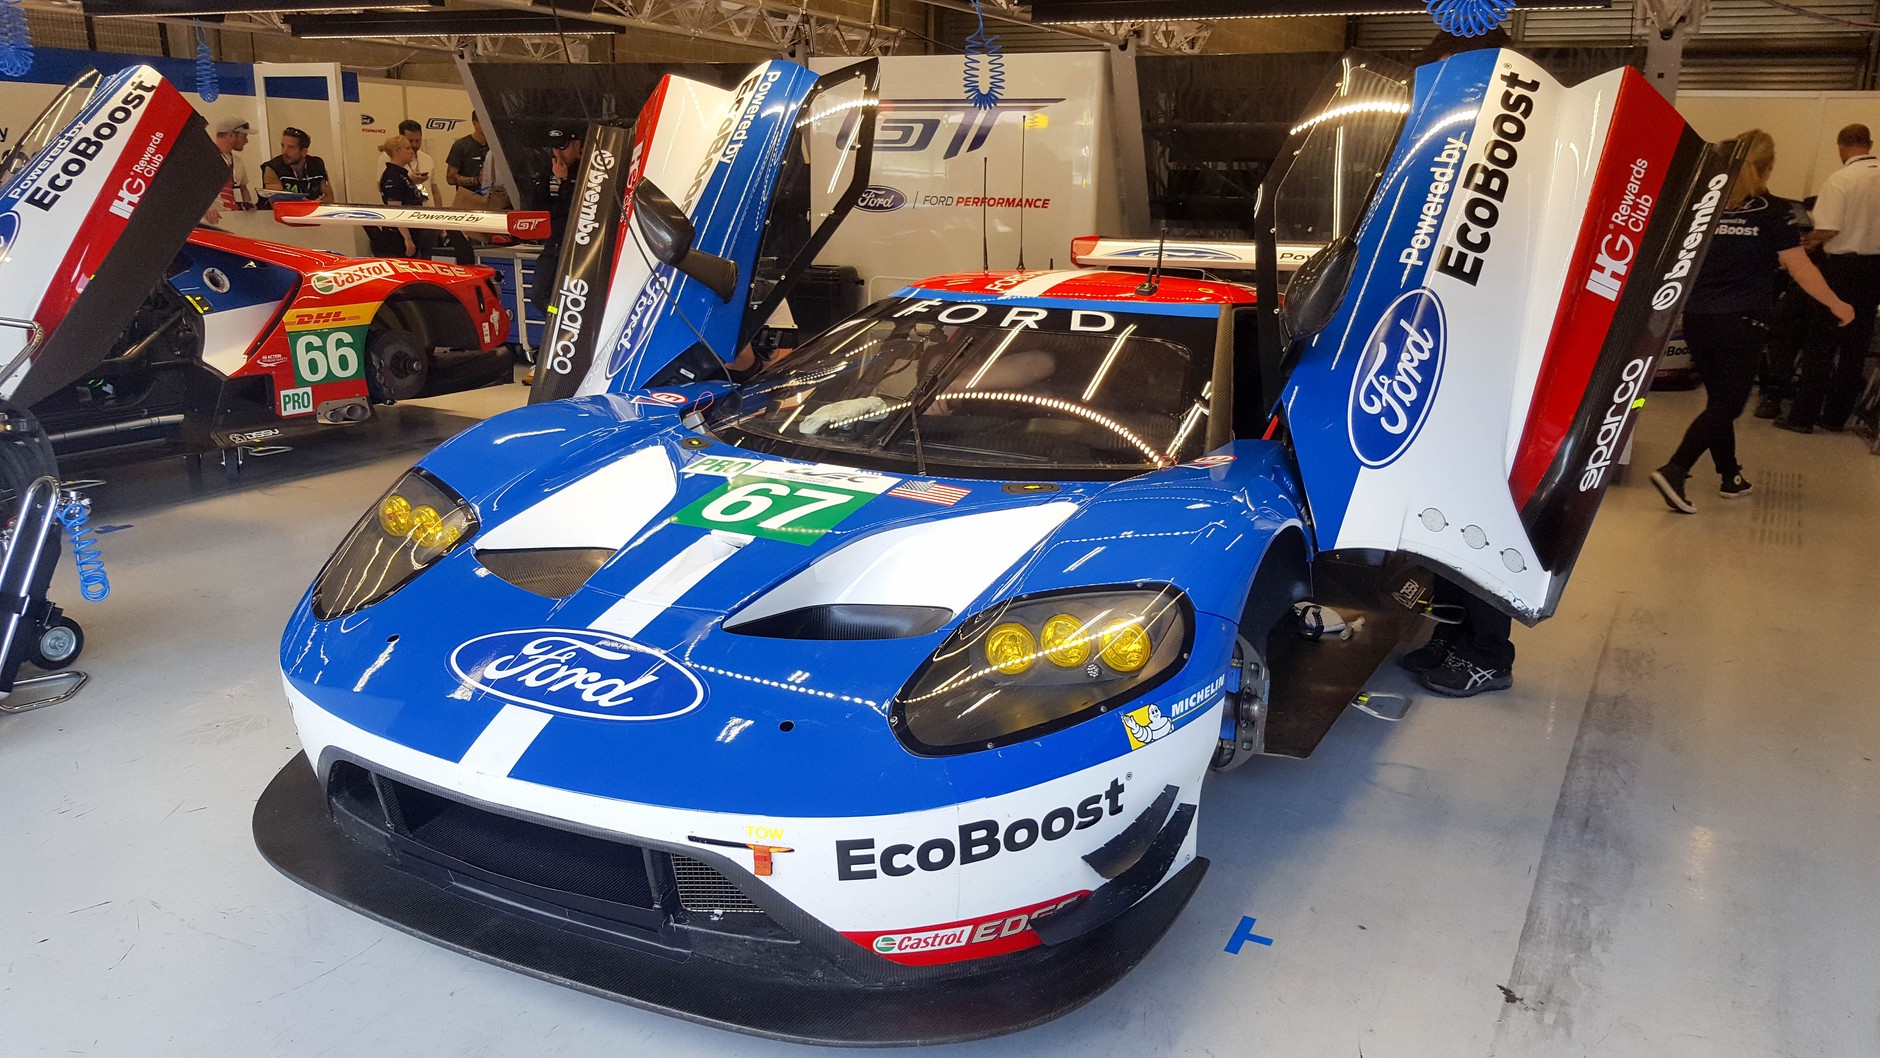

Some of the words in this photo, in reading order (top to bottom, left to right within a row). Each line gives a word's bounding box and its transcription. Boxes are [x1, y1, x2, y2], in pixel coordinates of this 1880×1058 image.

[426, 118, 466, 131] GT
[732, 71, 781, 141] Powered
[836, 98, 1067, 160] GT
[8, 134, 71, 199] Powered
[66, 120, 85, 142] by
[24, 80, 157, 212] EcoBoost
[144, 153, 164, 177] Club
[680, 74, 762, 213] EcoBoos
[719, 141, 744, 165] by
[108, 177, 146, 220] IHG
[133, 131, 164, 174] Rewards
[857, 190, 894, 209] Ford
[923, 195, 954, 207] FORD
[955, 196, 1051, 209] PERFORMANCE
[1434, 72, 1540, 287] EcoBoost
[408, 211, 467, 222] Powered
[468, 214, 484, 223] by
[513, 218, 548, 230] GT
[575, 170, 609, 245] brembo
[1399, 164, 1454, 266] Powered
[1434, 137, 1468, 163] by
[1628, 195, 1653, 232] Club
[1663, 173, 1728, 281] brembo
[1585, 233, 1634, 301] IHG
[1612, 158, 1648, 226] Rewards
[1714, 225, 1760, 236] Boost
[331, 262, 391, 287] Castrol
[394, 260, 473, 277] EDGE
[295, 311, 349, 325] DHL
[552, 277, 589, 375] sparco
[617, 272, 668, 351] Ford
[892, 297, 1116, 333] FORD
[296, 331, 358, 382] 66
[1359, 319, 1434, 434] Ford
[282, 391, 311, 411] PRO
[1579, 358, 1646, 493] sparco
[689, 458, 752, 473] PRO
[701, 482, 855, 530] 67
[484, 637, 659, 707] Ford
[1172, 674, 1225, 717] MICHELIN
[745, 826, 784, 840] TOW
[836, 777, 1124, 881] EcoBoost
[897, 930, 964, 952] Castrol
